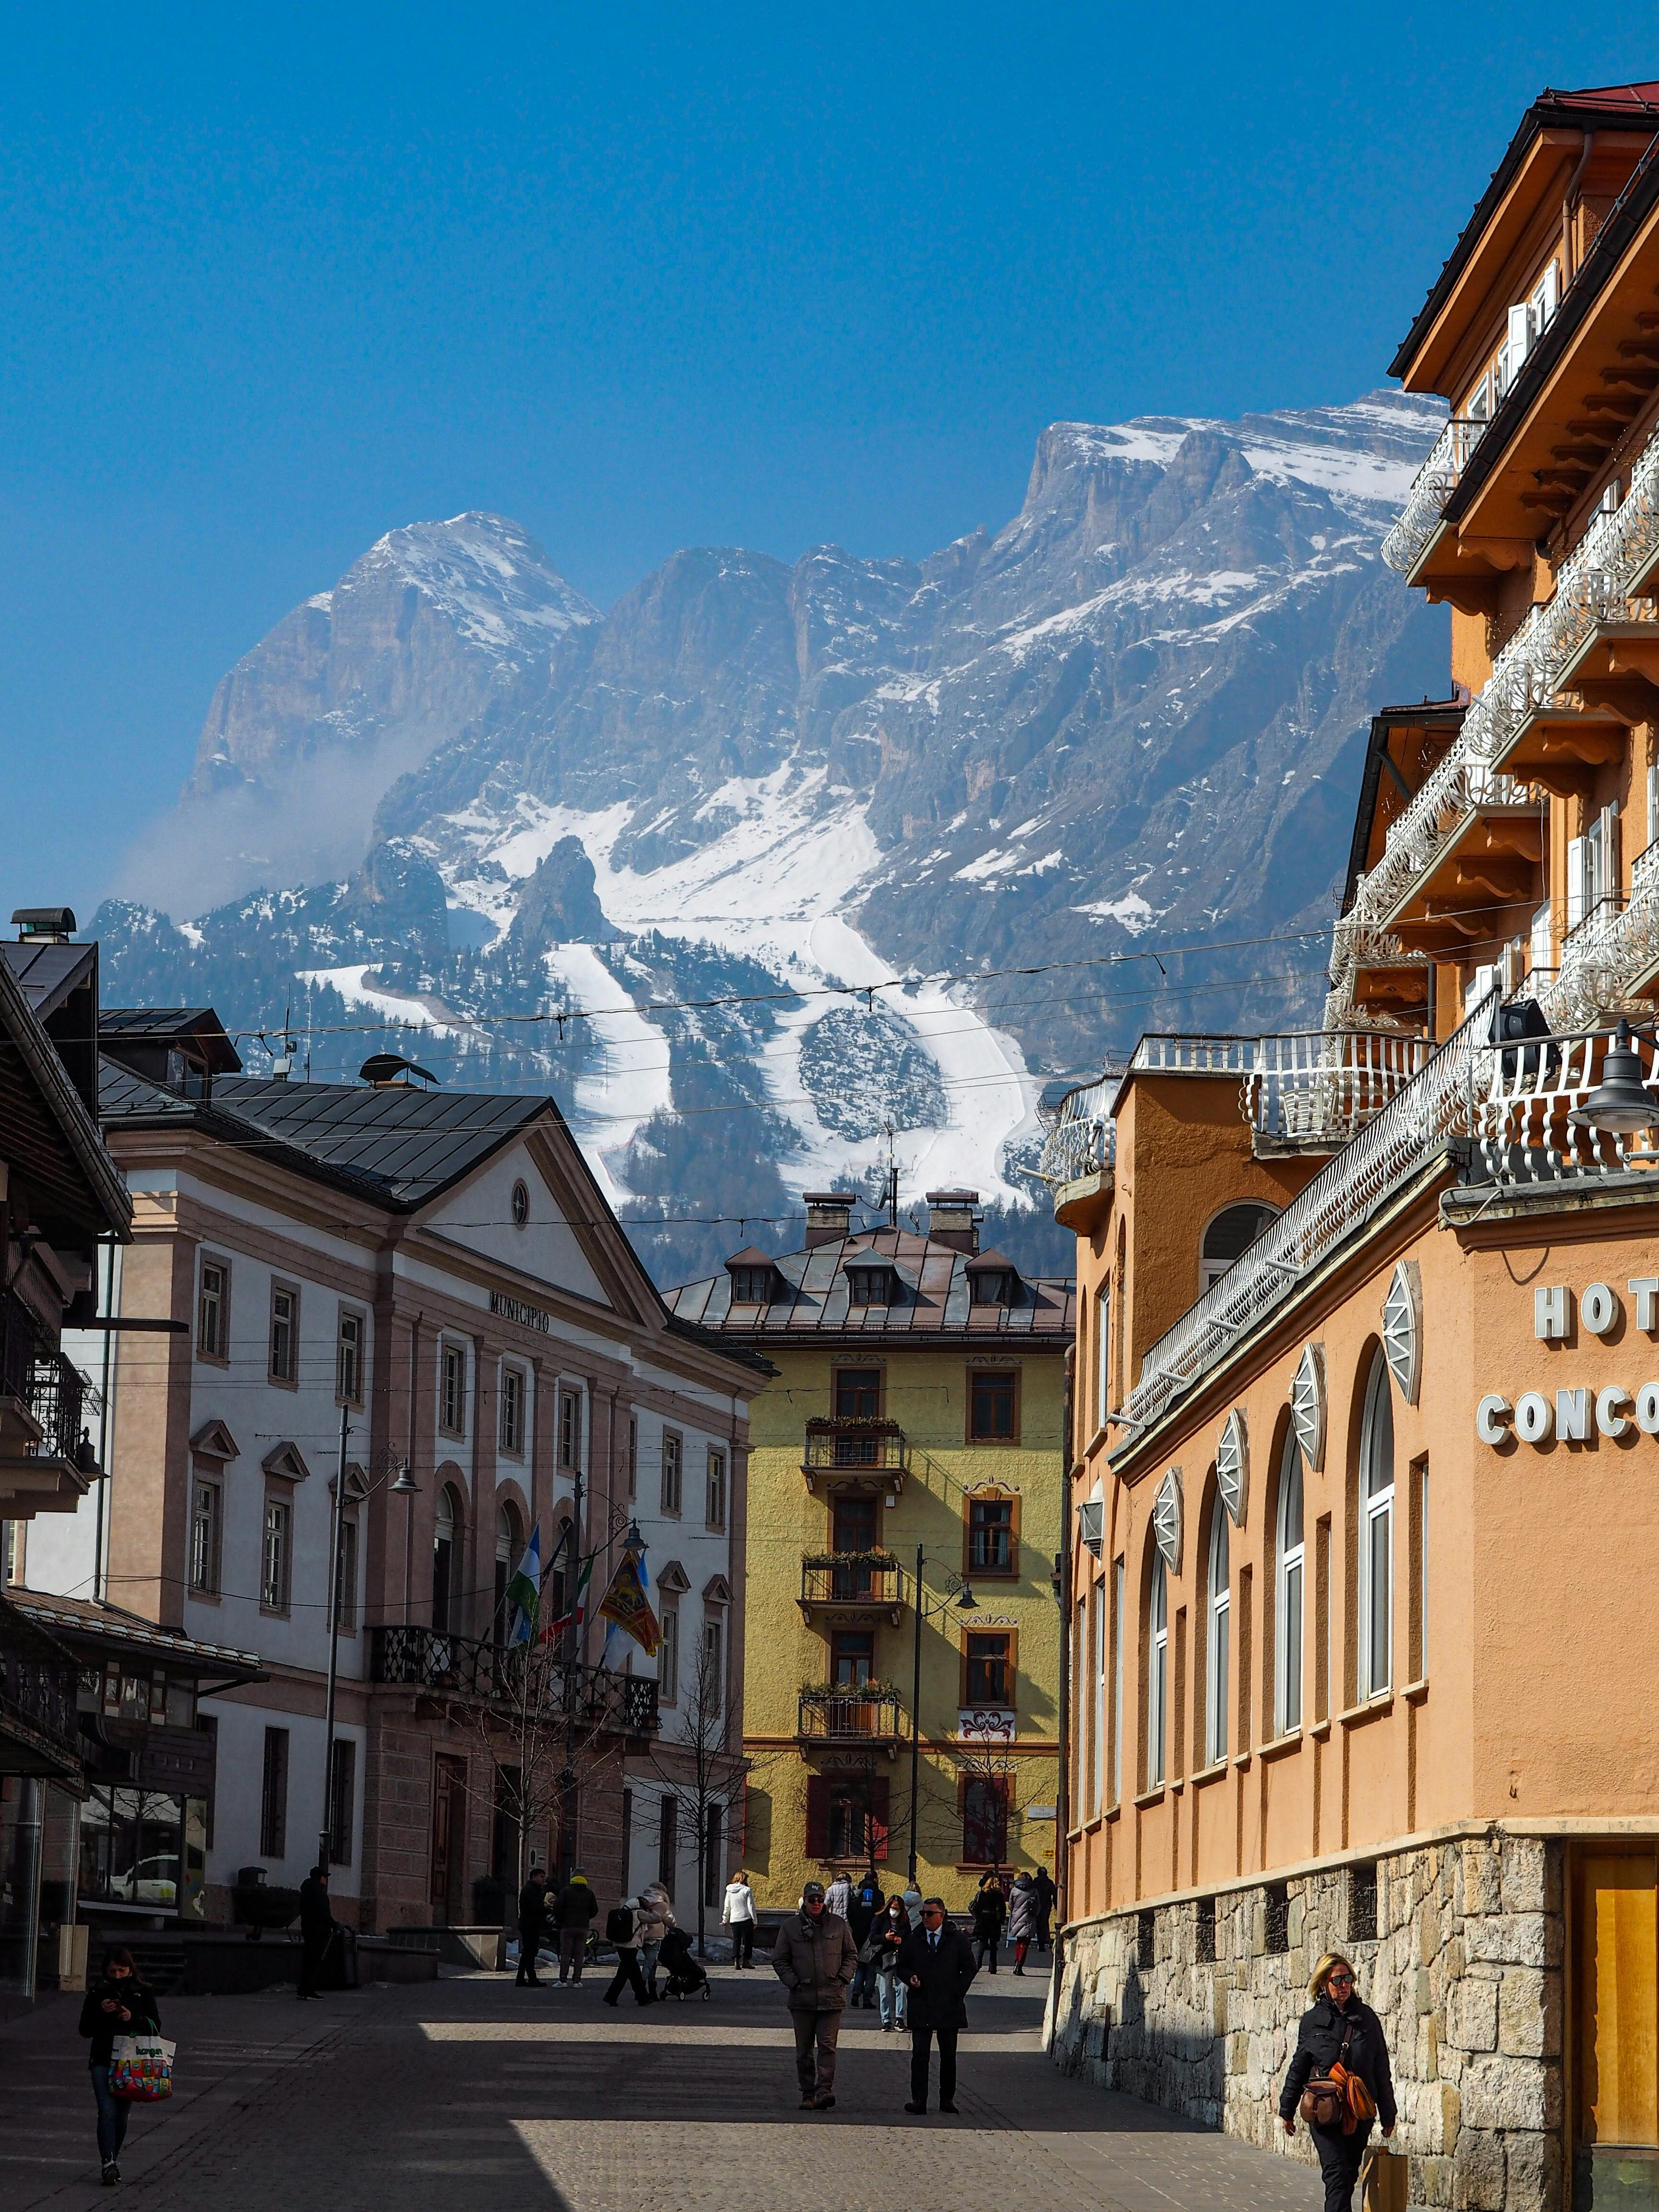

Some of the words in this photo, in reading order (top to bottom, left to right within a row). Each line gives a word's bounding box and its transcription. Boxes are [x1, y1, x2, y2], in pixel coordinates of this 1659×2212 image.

[490, 1291, 549, 1333] MUNICIPIO
[1534, 1277, 1659, 1339] HOT
[1477, 1382, 1659, 1446] CONCO
